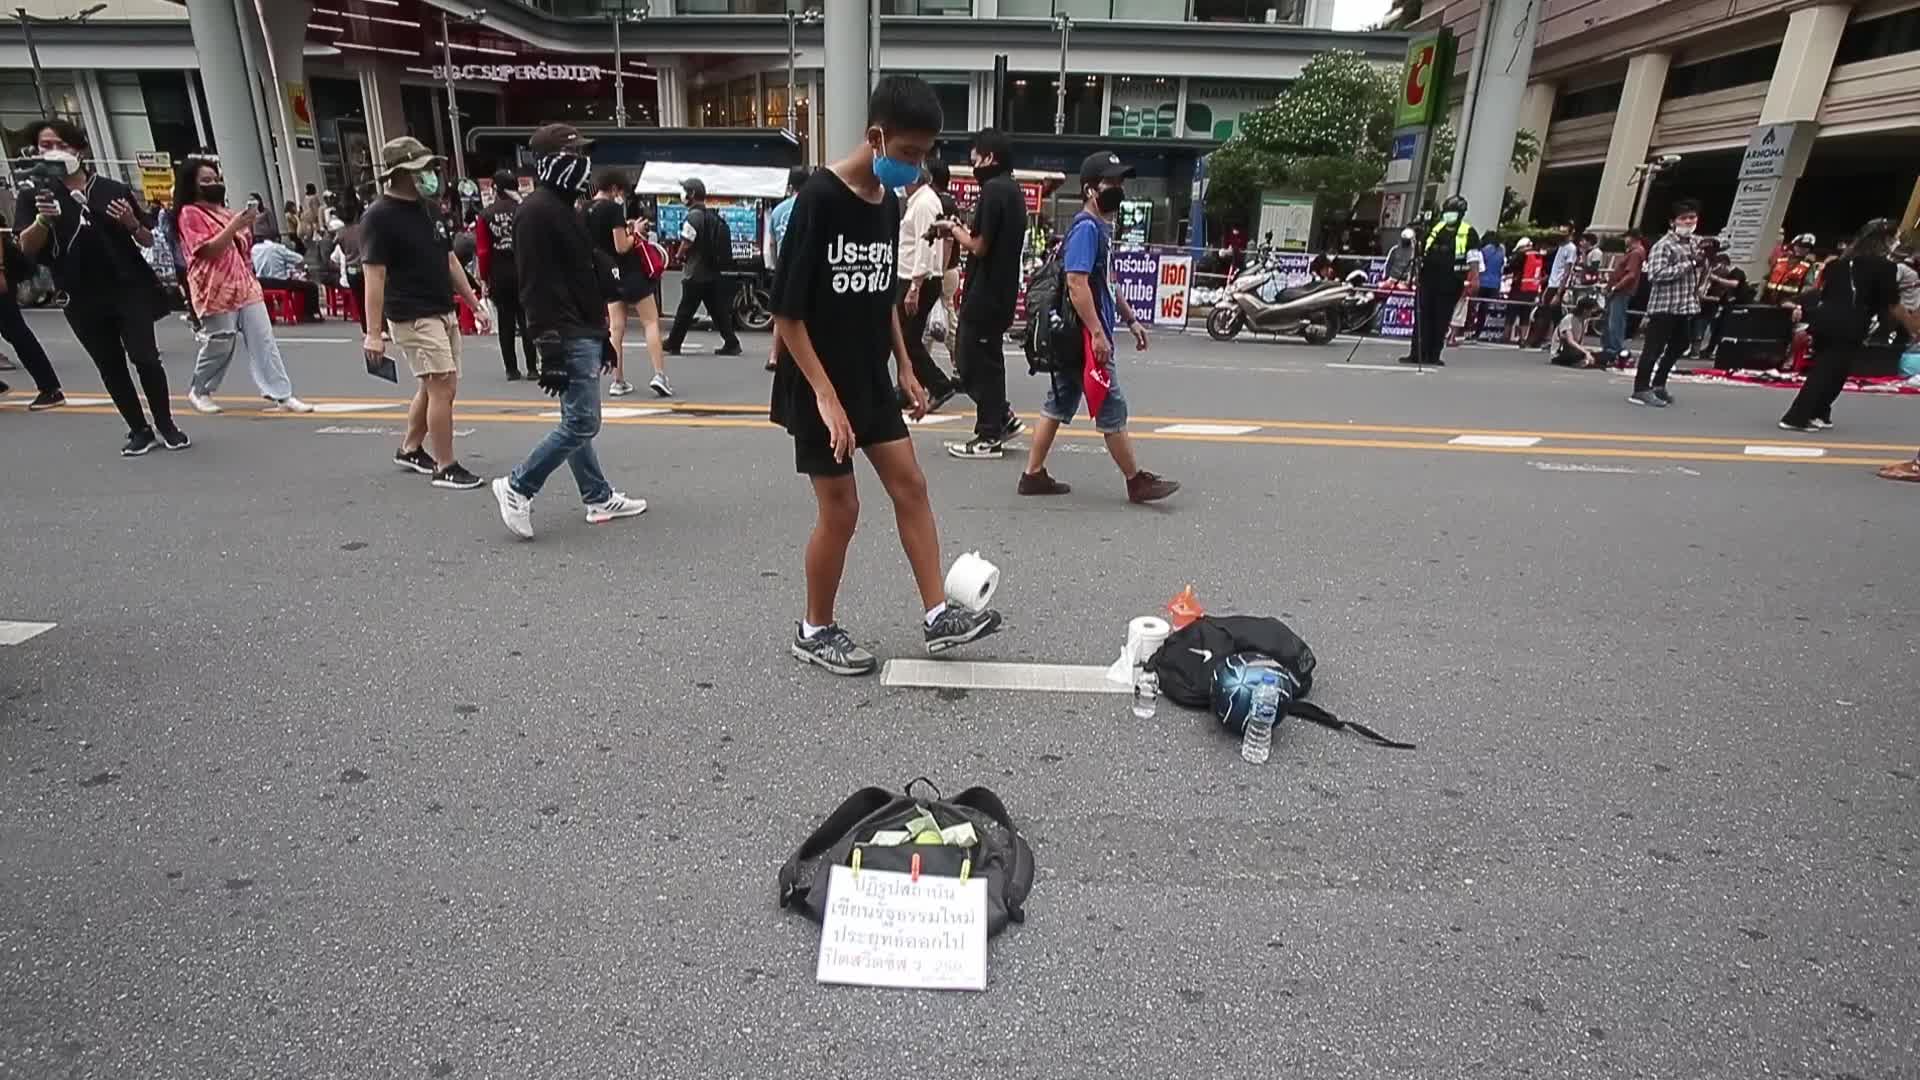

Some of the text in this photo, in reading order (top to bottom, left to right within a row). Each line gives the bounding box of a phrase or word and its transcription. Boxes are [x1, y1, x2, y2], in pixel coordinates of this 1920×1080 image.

[1745, 147, 1785, 159] ARNOMA
[1161, 263, 1187, 286] แจก
[1161, 290, 1184, 319] ฟรี
